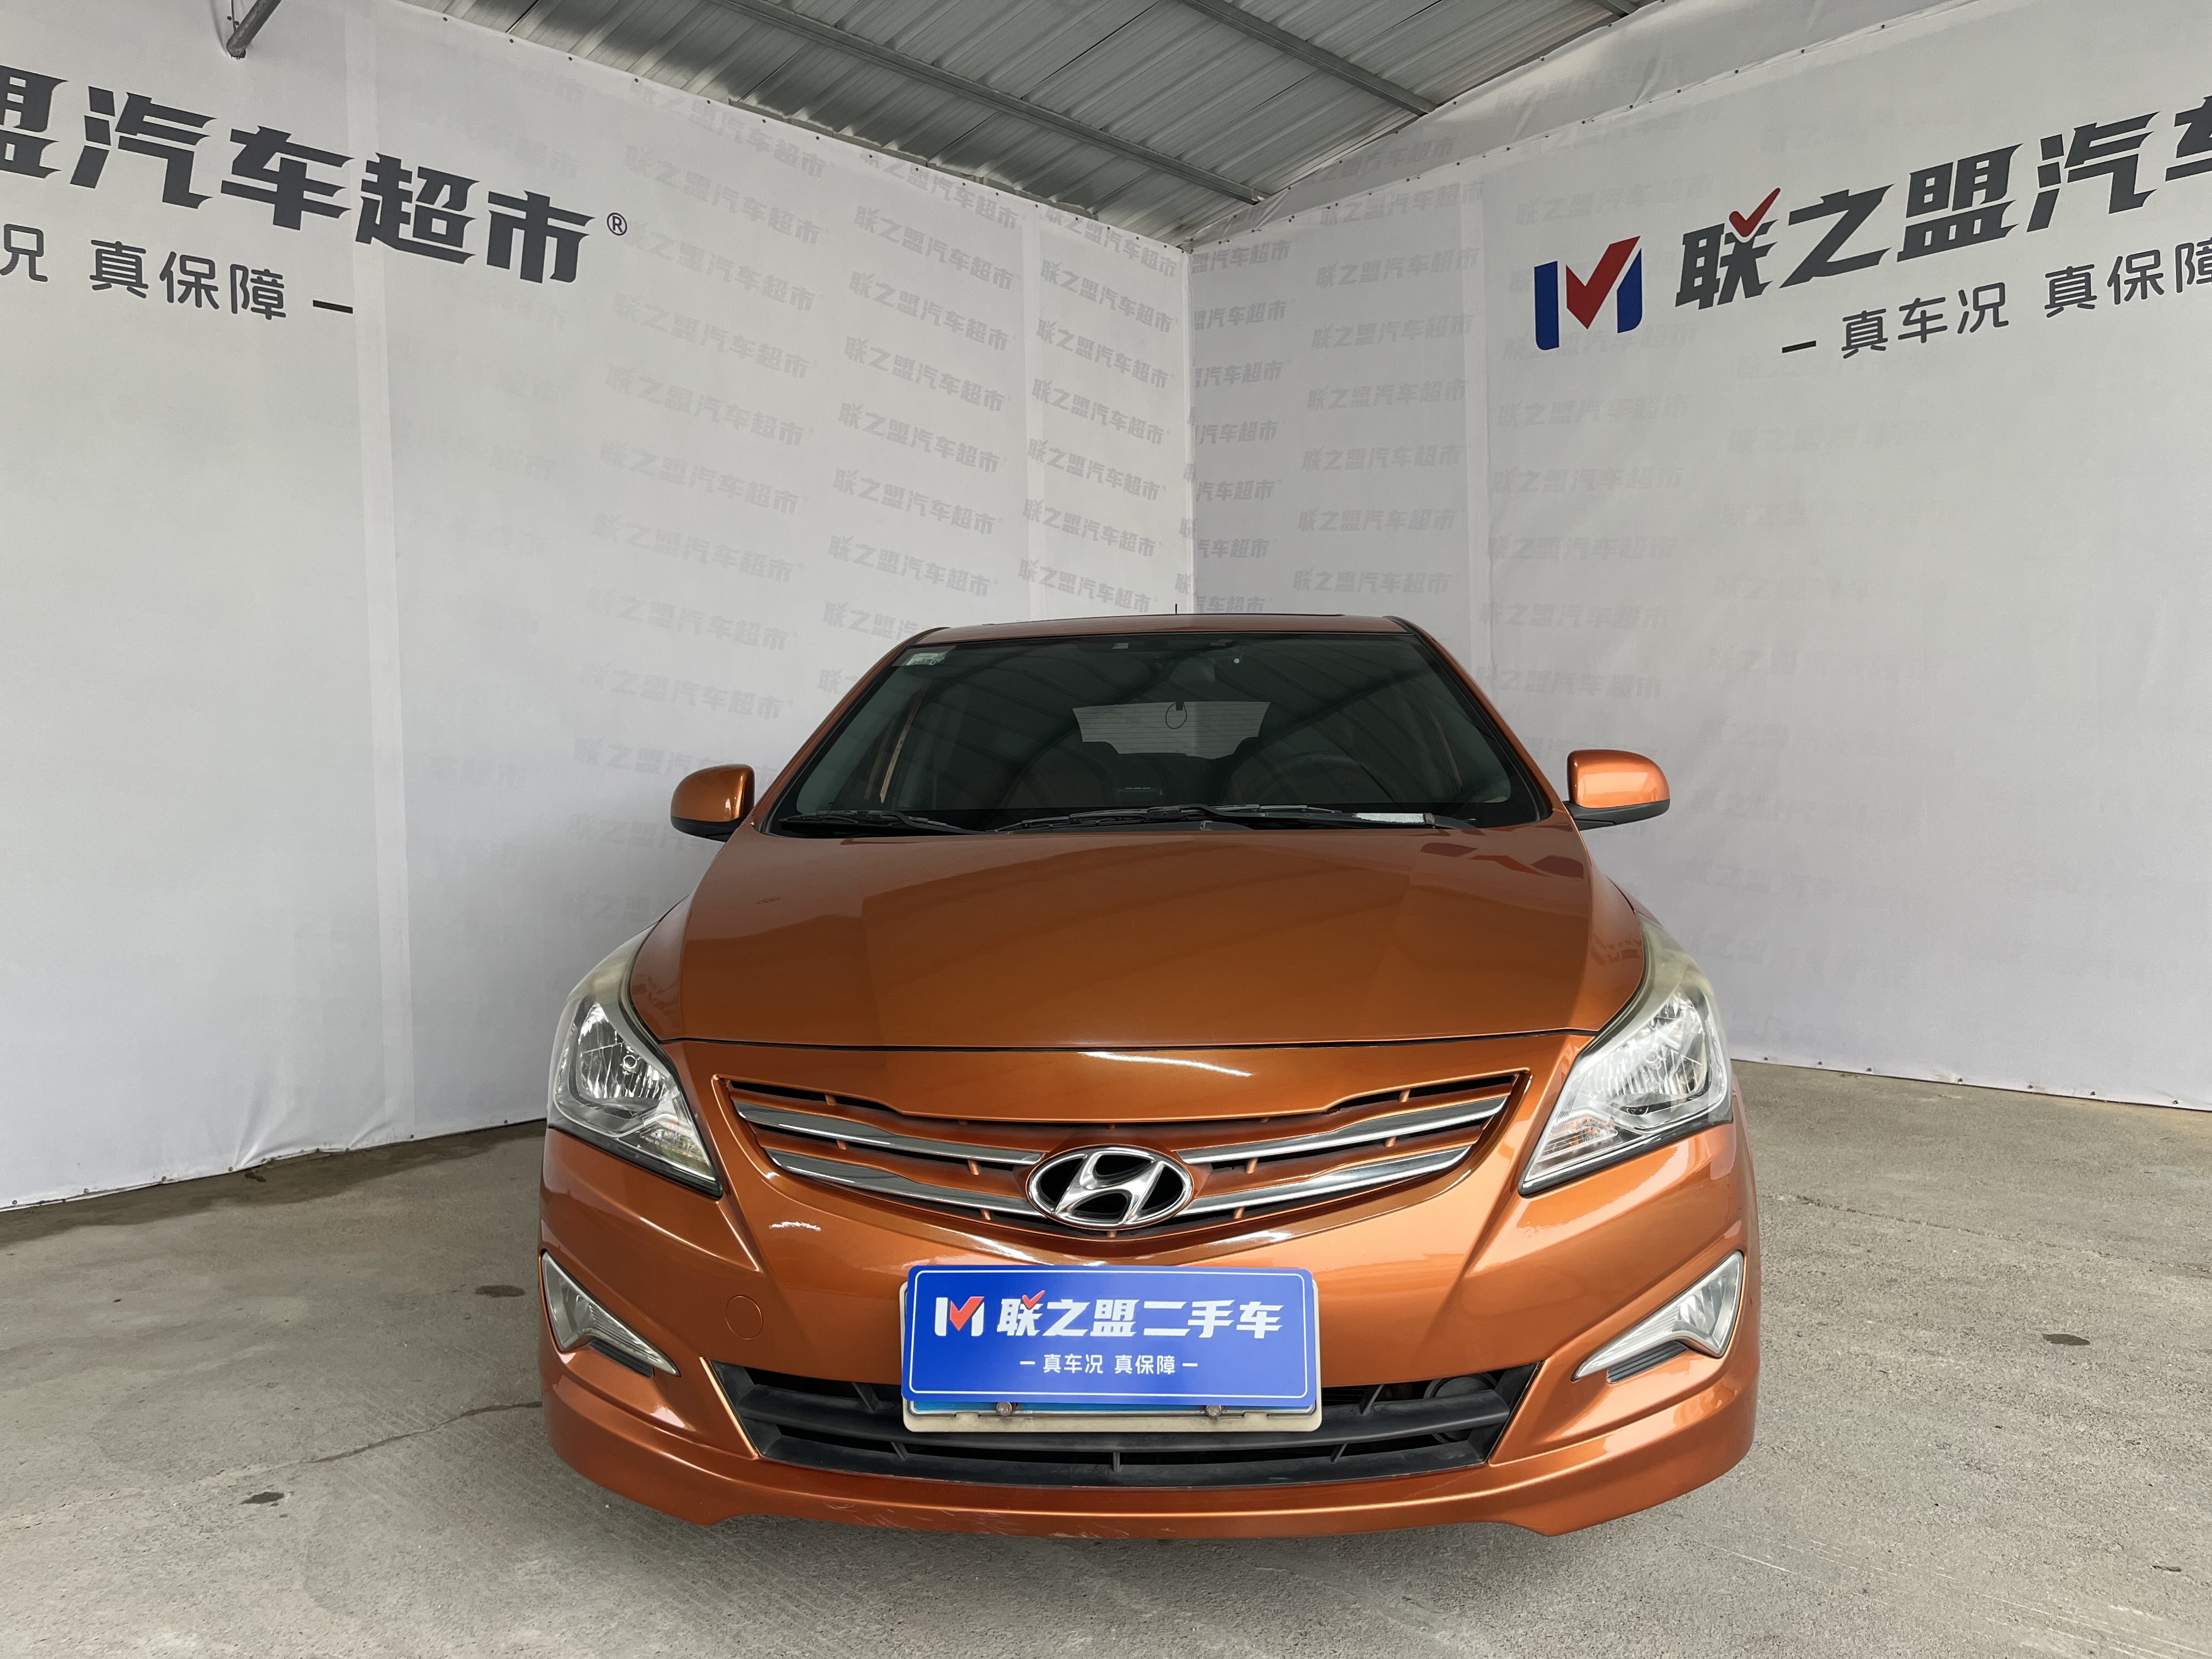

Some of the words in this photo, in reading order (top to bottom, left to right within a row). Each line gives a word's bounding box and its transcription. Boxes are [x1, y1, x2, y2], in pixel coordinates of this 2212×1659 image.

[624, 144, 821, 245] 联之盟汽车超市
[854, 205, 1014, 290] 联之盟汽车超市
[1315, 246, 1481, 289] 联之盟汽车超市
[89, 239, 286, 320] 真保障
[848, 270, 1009, 351] 联之盟汽车超市
[1040, 259, 1173, 334] 联之盟汽车超市
[1310, 312, 1476, 349] 联之盟汽车超市
[1841, 283, 2010, 360] 真车况
[843, 336, 1005, 412] 联之盟汽车超市
[1036, 318, 1170, 389] 联之盟汽车超市
[605, 364, 805, 447] 联之盟汽车超市
[1031, 377, 1165, 445] 联之盟汽车超市
[1306, 377, 1469, 410] 联之盟汽车超市
[838, 402, 1001, 473] 联之盟汽车超市
[1195, 419, 1280, 445] 汽车超市
[1301, 443, 1464, 472] 联之盟汽车超市
[1026, 438, 1161, 501] 联之盟汽车超市
[832, 468, 996, 535] 联之盟汽车超市
[1022, 498, 1156, 557] 联之盟汽车超市
[1297, 506, 1458, 532] 联之盟汽车超市
[827, 534, 991, 597] 联之盟汽车超市
[1017, 558, 1152, 613] 联之盟汽车超市
[1292, 566, 1453, 594] 联之盟汽车超市
[996, 1289, 1284, 1339] 联之盟二手车
[1043, 1354, 1103, 1375] 真车况
[1115, 1354, 1176, 1376] 真保障
